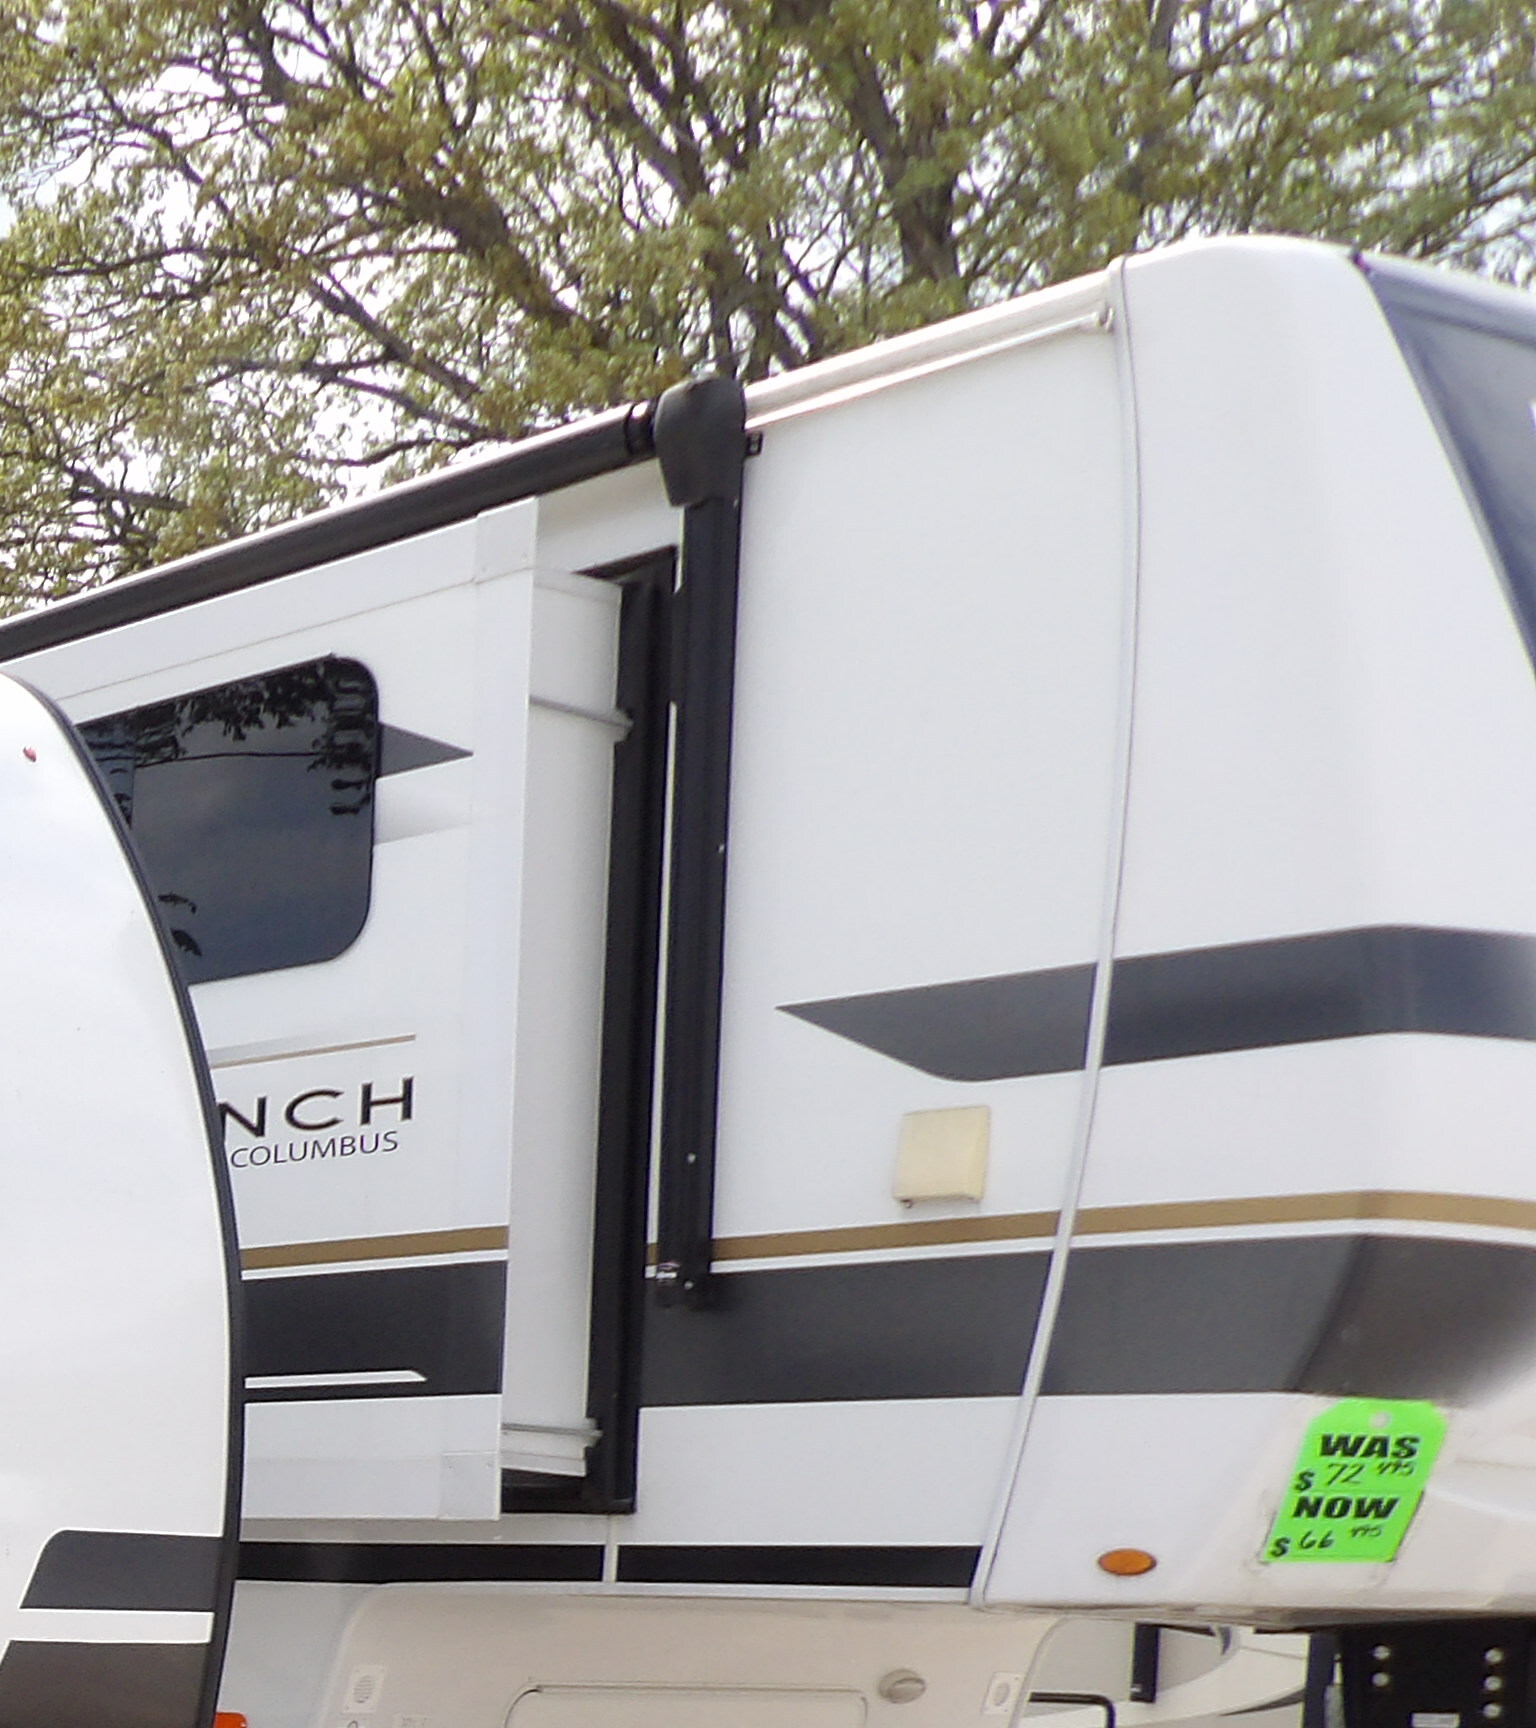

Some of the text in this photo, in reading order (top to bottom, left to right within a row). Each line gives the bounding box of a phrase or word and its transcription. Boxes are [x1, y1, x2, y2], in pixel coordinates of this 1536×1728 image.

[217, 1075, 415, 1143] NCH
[230, 1130, 399, 1169] COLUMBUS
[1319, 1433, 1421, 1459] WAS
[1326, 1462, 1366, 1486] 72
[1291, 1496, 1401, 1519] NOW
[1299, 1530, 1335, 1549] 66
